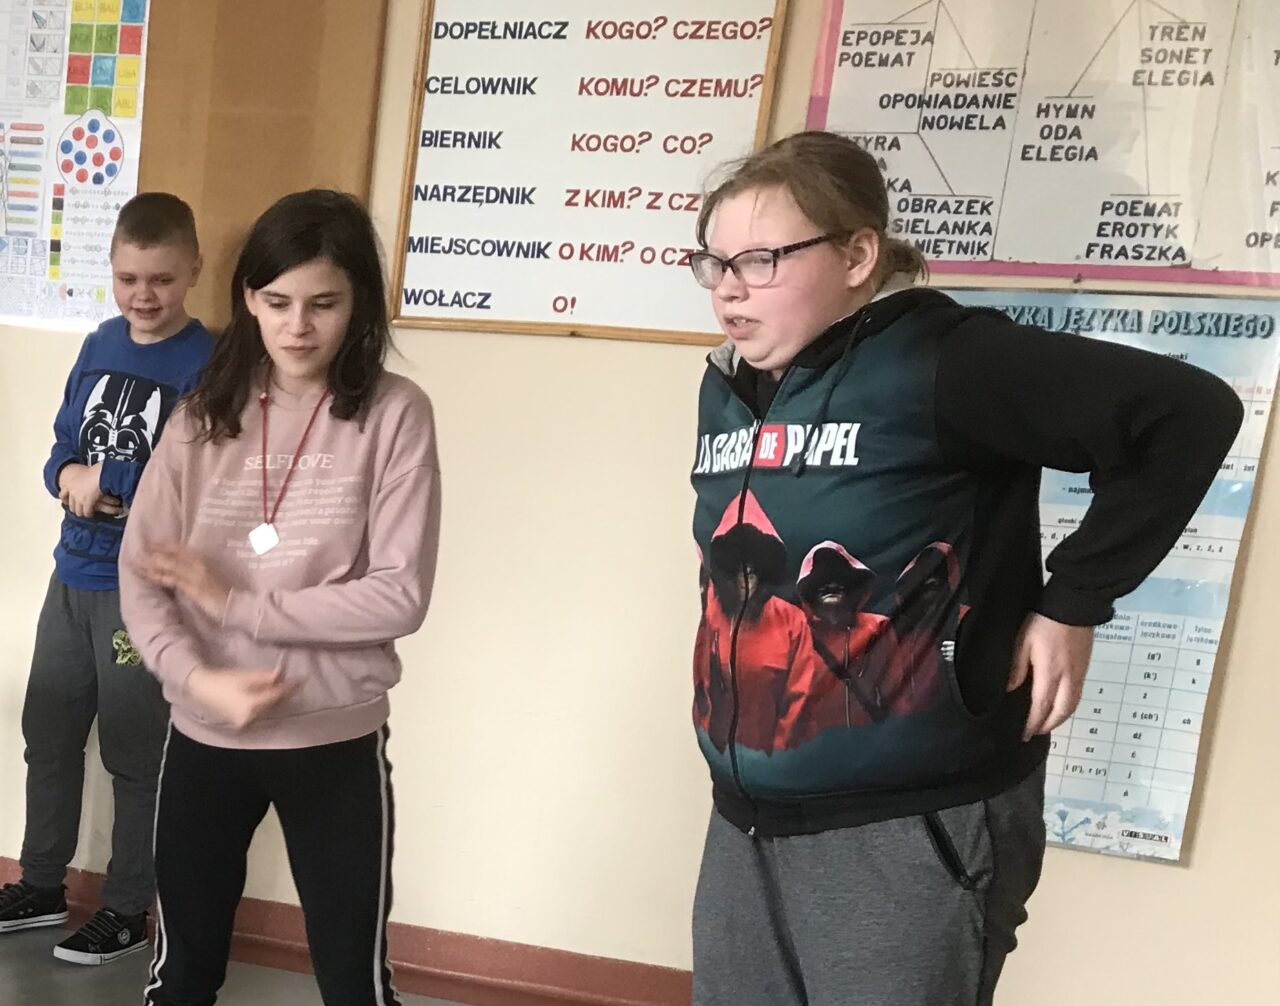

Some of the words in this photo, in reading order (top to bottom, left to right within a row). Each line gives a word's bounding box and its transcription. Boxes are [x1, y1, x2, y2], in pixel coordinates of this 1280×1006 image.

[433, 20, 569, 40] DOPEŁNIACZ
[585, 15, 668, 40] KOGO?
[672, 16, 773, 40] CZEGO?
[1148, 24, 1206, 42] TREN
[842, 29, 935, 48] EPOPEJA
[838, 51, 915, 68] POEMAT
[1140, 47, 1213, 65] SONET
[424, 75, 538, 96] CELOWNIK
[578, 74, 659, 97] KOMU?
[664, 73, 764, 98] CZEMU?
[1132, 69, 1215, 87] ELEGIA
[878, 92, 1018, 110] OPOWIADANIE
[1035, 102, 1096, 120] HYMN
[921, 113, 1007, 131] NOWELA
[1039, 123, 1083, 142] ODA
[421, 130, 504, 150] BIERNIK
[571, 131, 652, 154] KOGO?
[663, 132, 713, 155] CO?
[1020, 144, 1099, 162] ELEGIA
[414, 184, 537, 209] NARZĘDNIK
[564, 189, 580, 207] Z
[584, 186, 642, 210] KIM?
[646, 192, 662, 210] Z
[897, 197, 994, 216] OBRAZEK
[1100, 200, 1183, 218] POEMAT
[891, 217, 993, 236] SIELANKA
[1096, 221, 1179, 239] EROTYK
[407, 235, 553, 260] MIEJSCOWNIK
[558, 242, 575, 260] O
[579, 241, 635, 264] KIM?
[640, 247, 656, 264] O
[1085, 241, 1187, 262] FRASZKA
[403, 287, 492, 310] WOŁACZ
[552, 295, 577, 315] O!
[1058, 306, 1143, 335] JĘZYKA
[1149, 309, 1276, 340] POLSKIEGO
[693, 433, 711, 474] LA
[712, 426, 755, 473] CASA
[759, 432, 779, 460] DE
[782, 422, 862, 467] PAPEL
